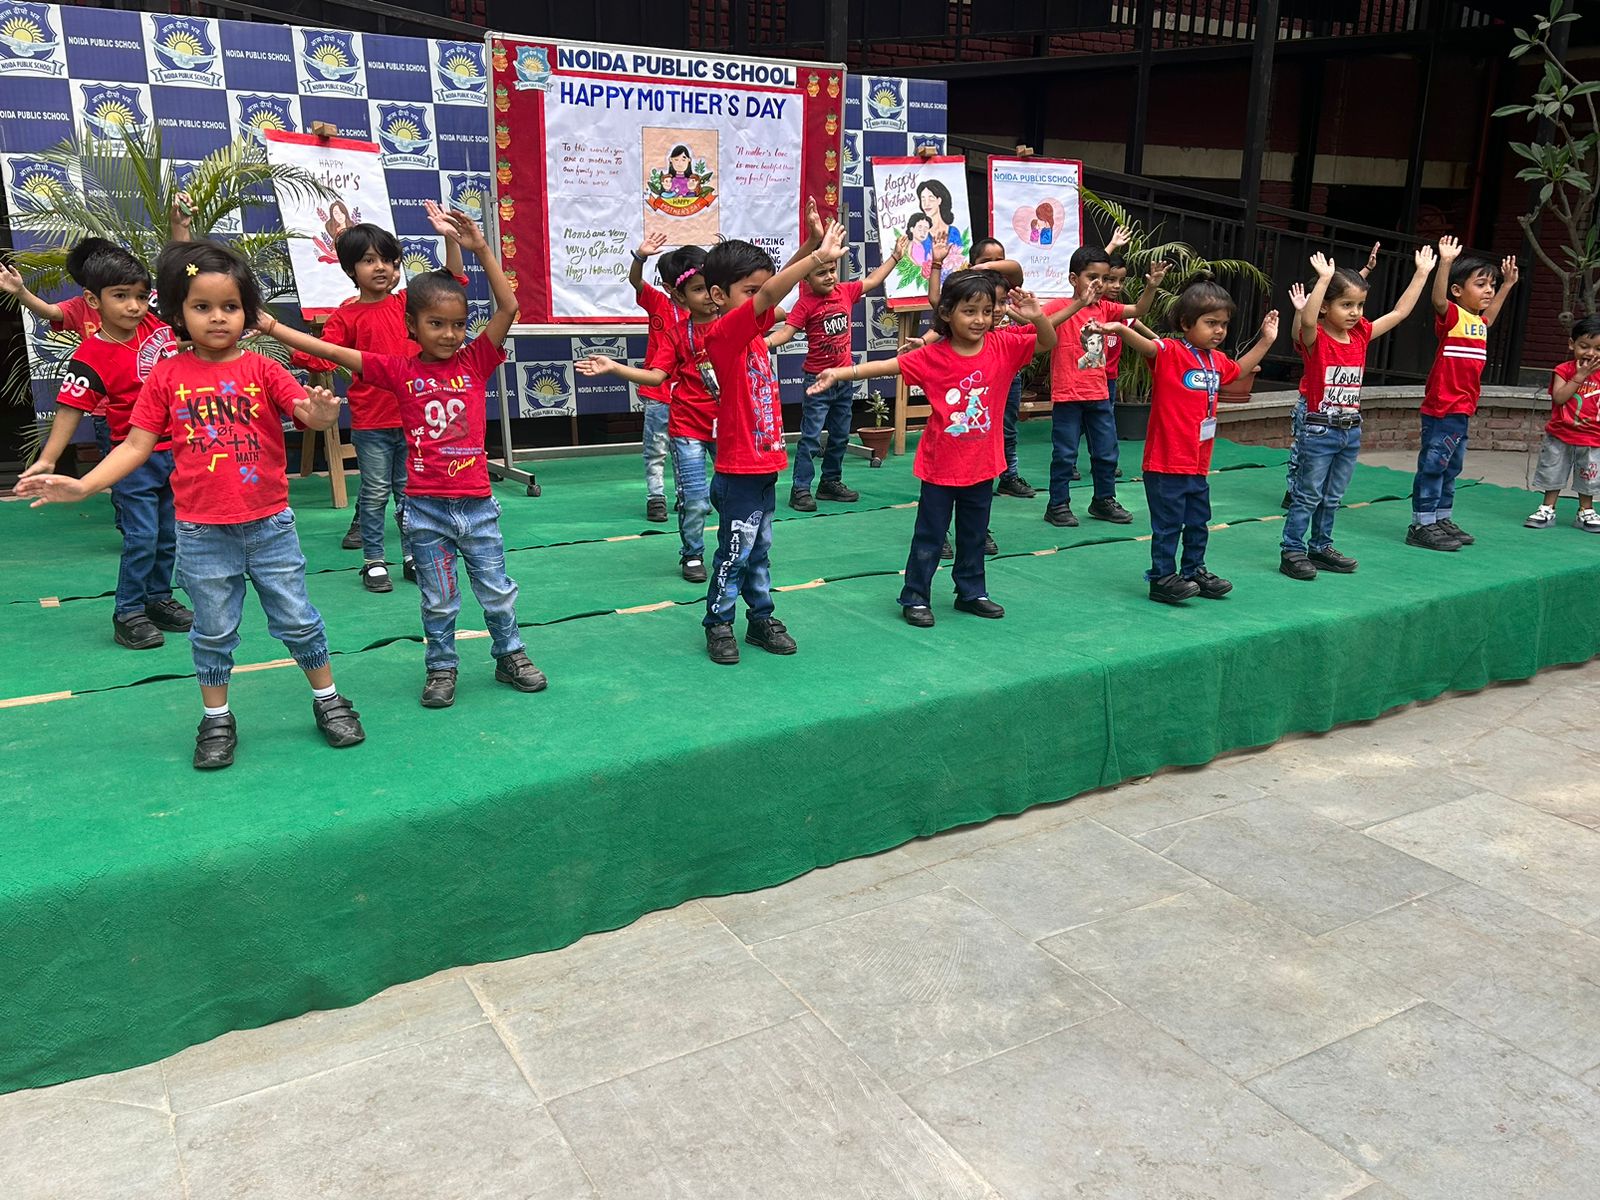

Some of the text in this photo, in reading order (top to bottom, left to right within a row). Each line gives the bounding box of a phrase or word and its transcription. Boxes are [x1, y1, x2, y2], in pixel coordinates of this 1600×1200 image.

[68, 36, 141, 50] NOIDA PUBLIC SCHOOL
[225, 49, 291, 62] NOIDA PUBLIC SCHOOL
[1, 62, 16, 70] NOIDA
[34, 63, 52, 72] SCHOOL
[368, 61, 427, 73] NOIDA PUBLIC SCHOOL
[559, 48, 795, 86] NOIDA PUBLIC SCHOOL
[194, 74, 211, 83] SCHOOL
[339, 84, 354, 93] SCHOOL
[560, 81, 786, 119] HAPPY MOTHER'S DAY
[0, 110, 70, 121] OIDA PUBLIC SCHOOL
[158, 118, 227, 130] NOIDA PUBLIC SCHOOL
[346, 129, 368, 138] SCHOOL
[440, 134, 455, 142] NOIDA
[562, 143, 571, 152] To
[318, 158, 344, 169] HAPPY
[884, 171, 920, 193] Happy
[993, 172, 1077, 185] NOIDA PUBLIC SCHOOL
[881, 212, 907, 230] Day
[749, 237, 785, 246] AMAZING
[467, 264, 485, 272] PUBLIC
[187, 395, 252, 428] KING
[235, 451, 260, 463] MATH
